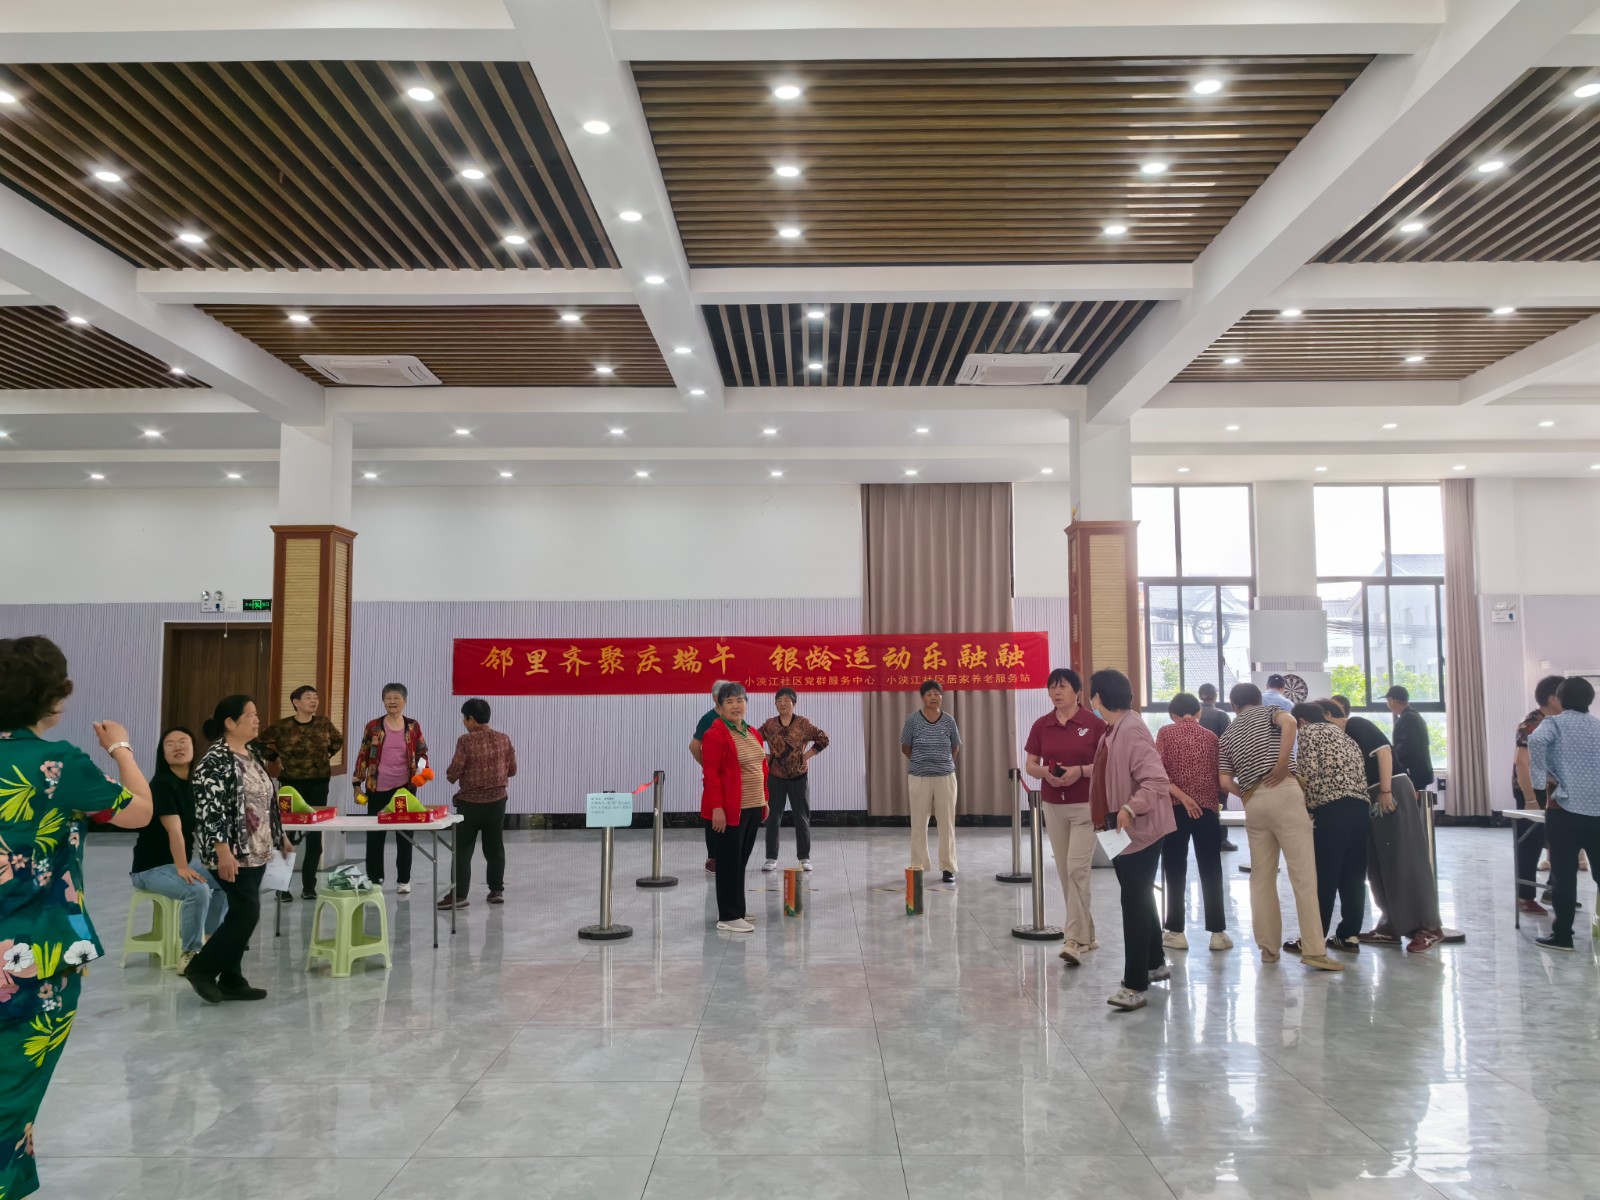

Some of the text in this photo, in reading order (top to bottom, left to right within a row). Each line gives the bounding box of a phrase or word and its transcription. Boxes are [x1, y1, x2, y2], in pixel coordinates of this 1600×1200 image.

[480, 641, 1026, 678] 邻里齐聚庆端午 银龄运动乐融融
